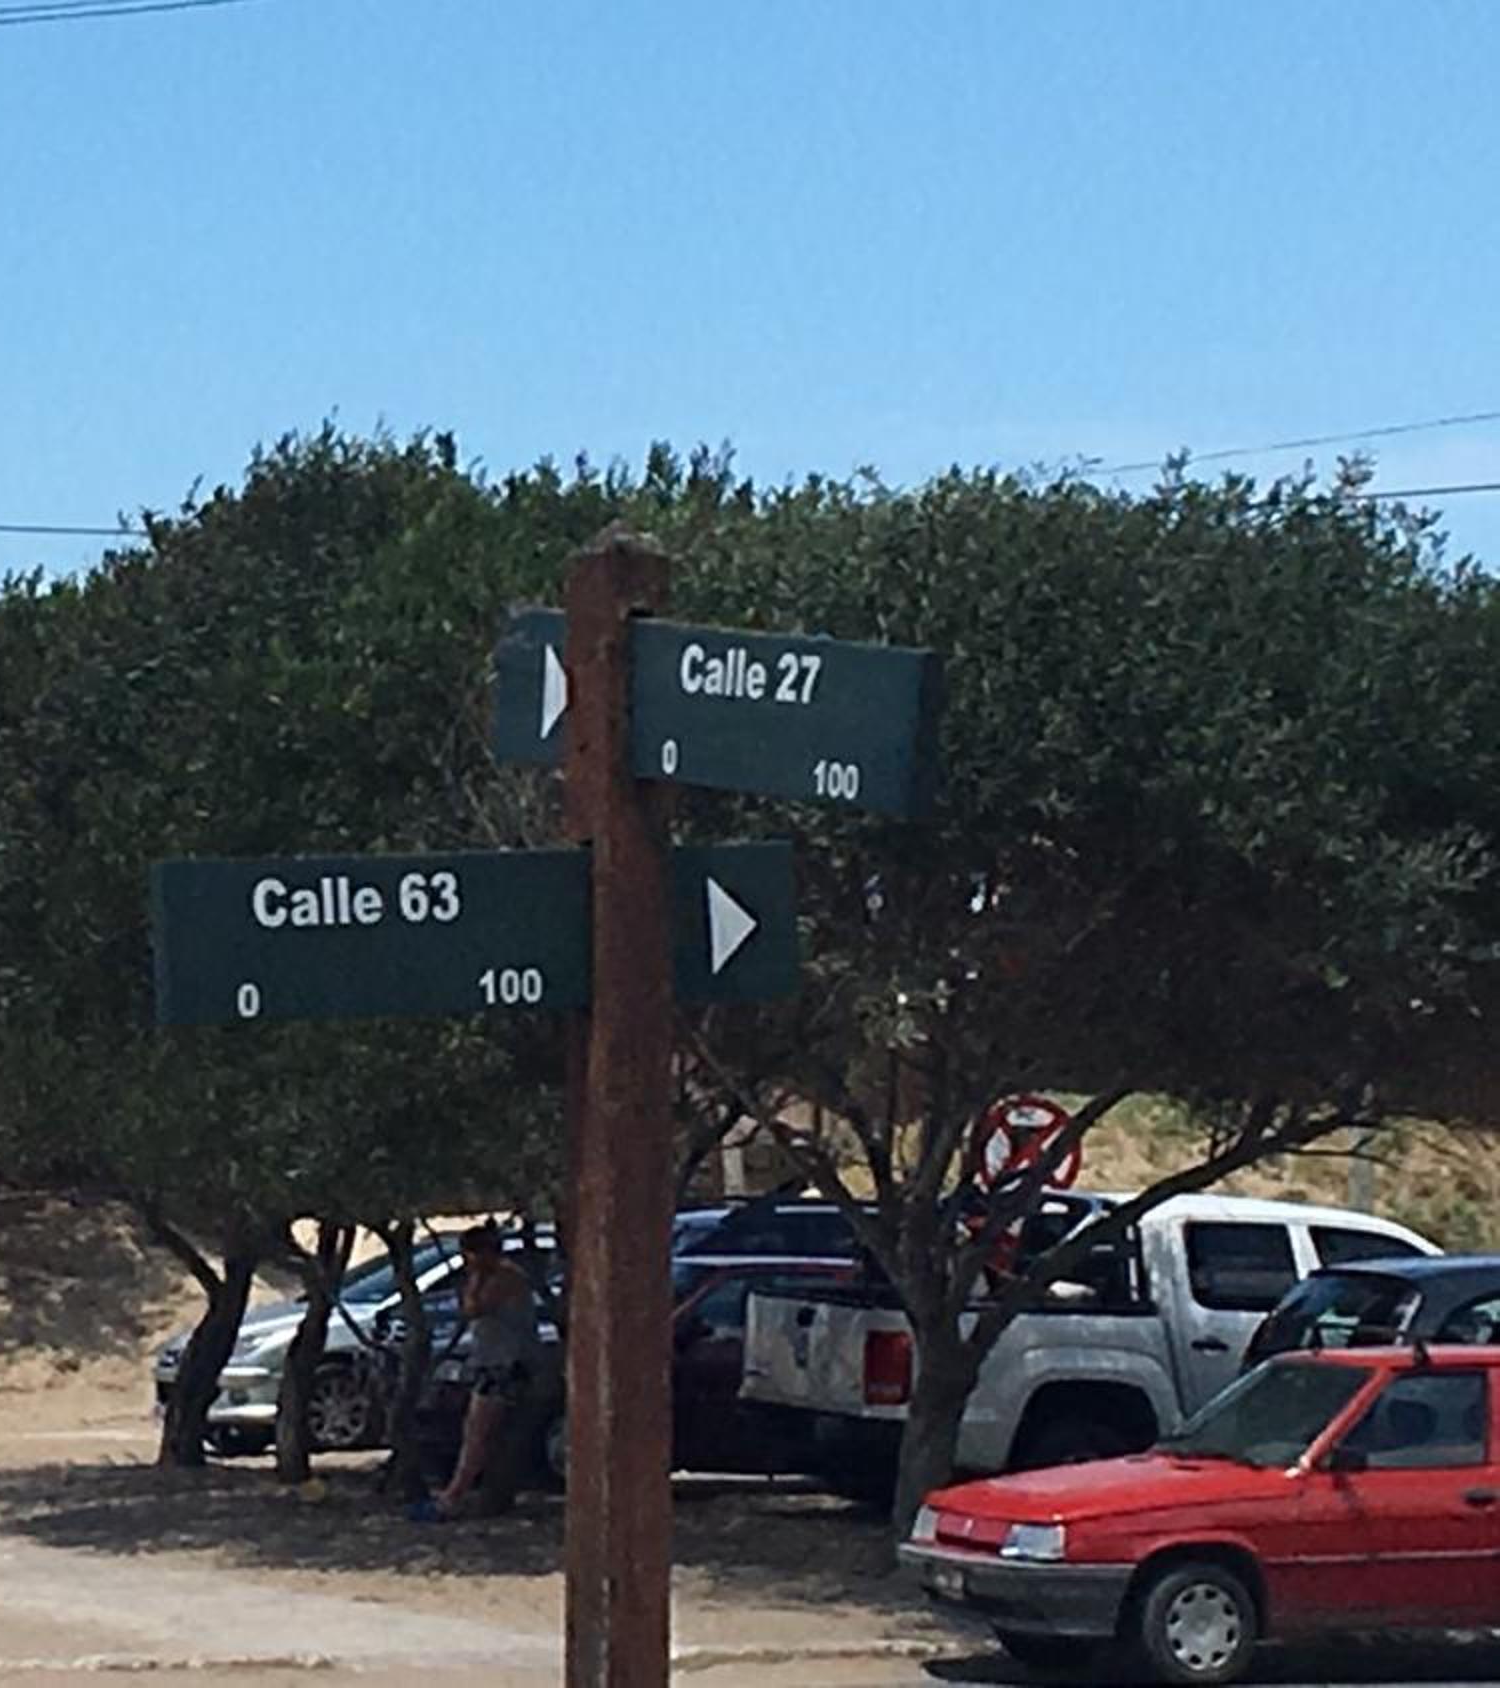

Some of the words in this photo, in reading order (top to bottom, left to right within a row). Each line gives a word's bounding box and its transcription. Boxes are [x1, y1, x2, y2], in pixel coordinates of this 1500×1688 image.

[680, 643, 767, 700] Calle
[775, 652, 821, 704] 27
[662, 739, 677, 775] 0
[813, 759, 860, 800] 100
[253, 876, 383, 927] Calle
[399, 872, 460, 921] 63
[237, 983, 260, 1017] 0
[479, 968, 542, 1004] 100
